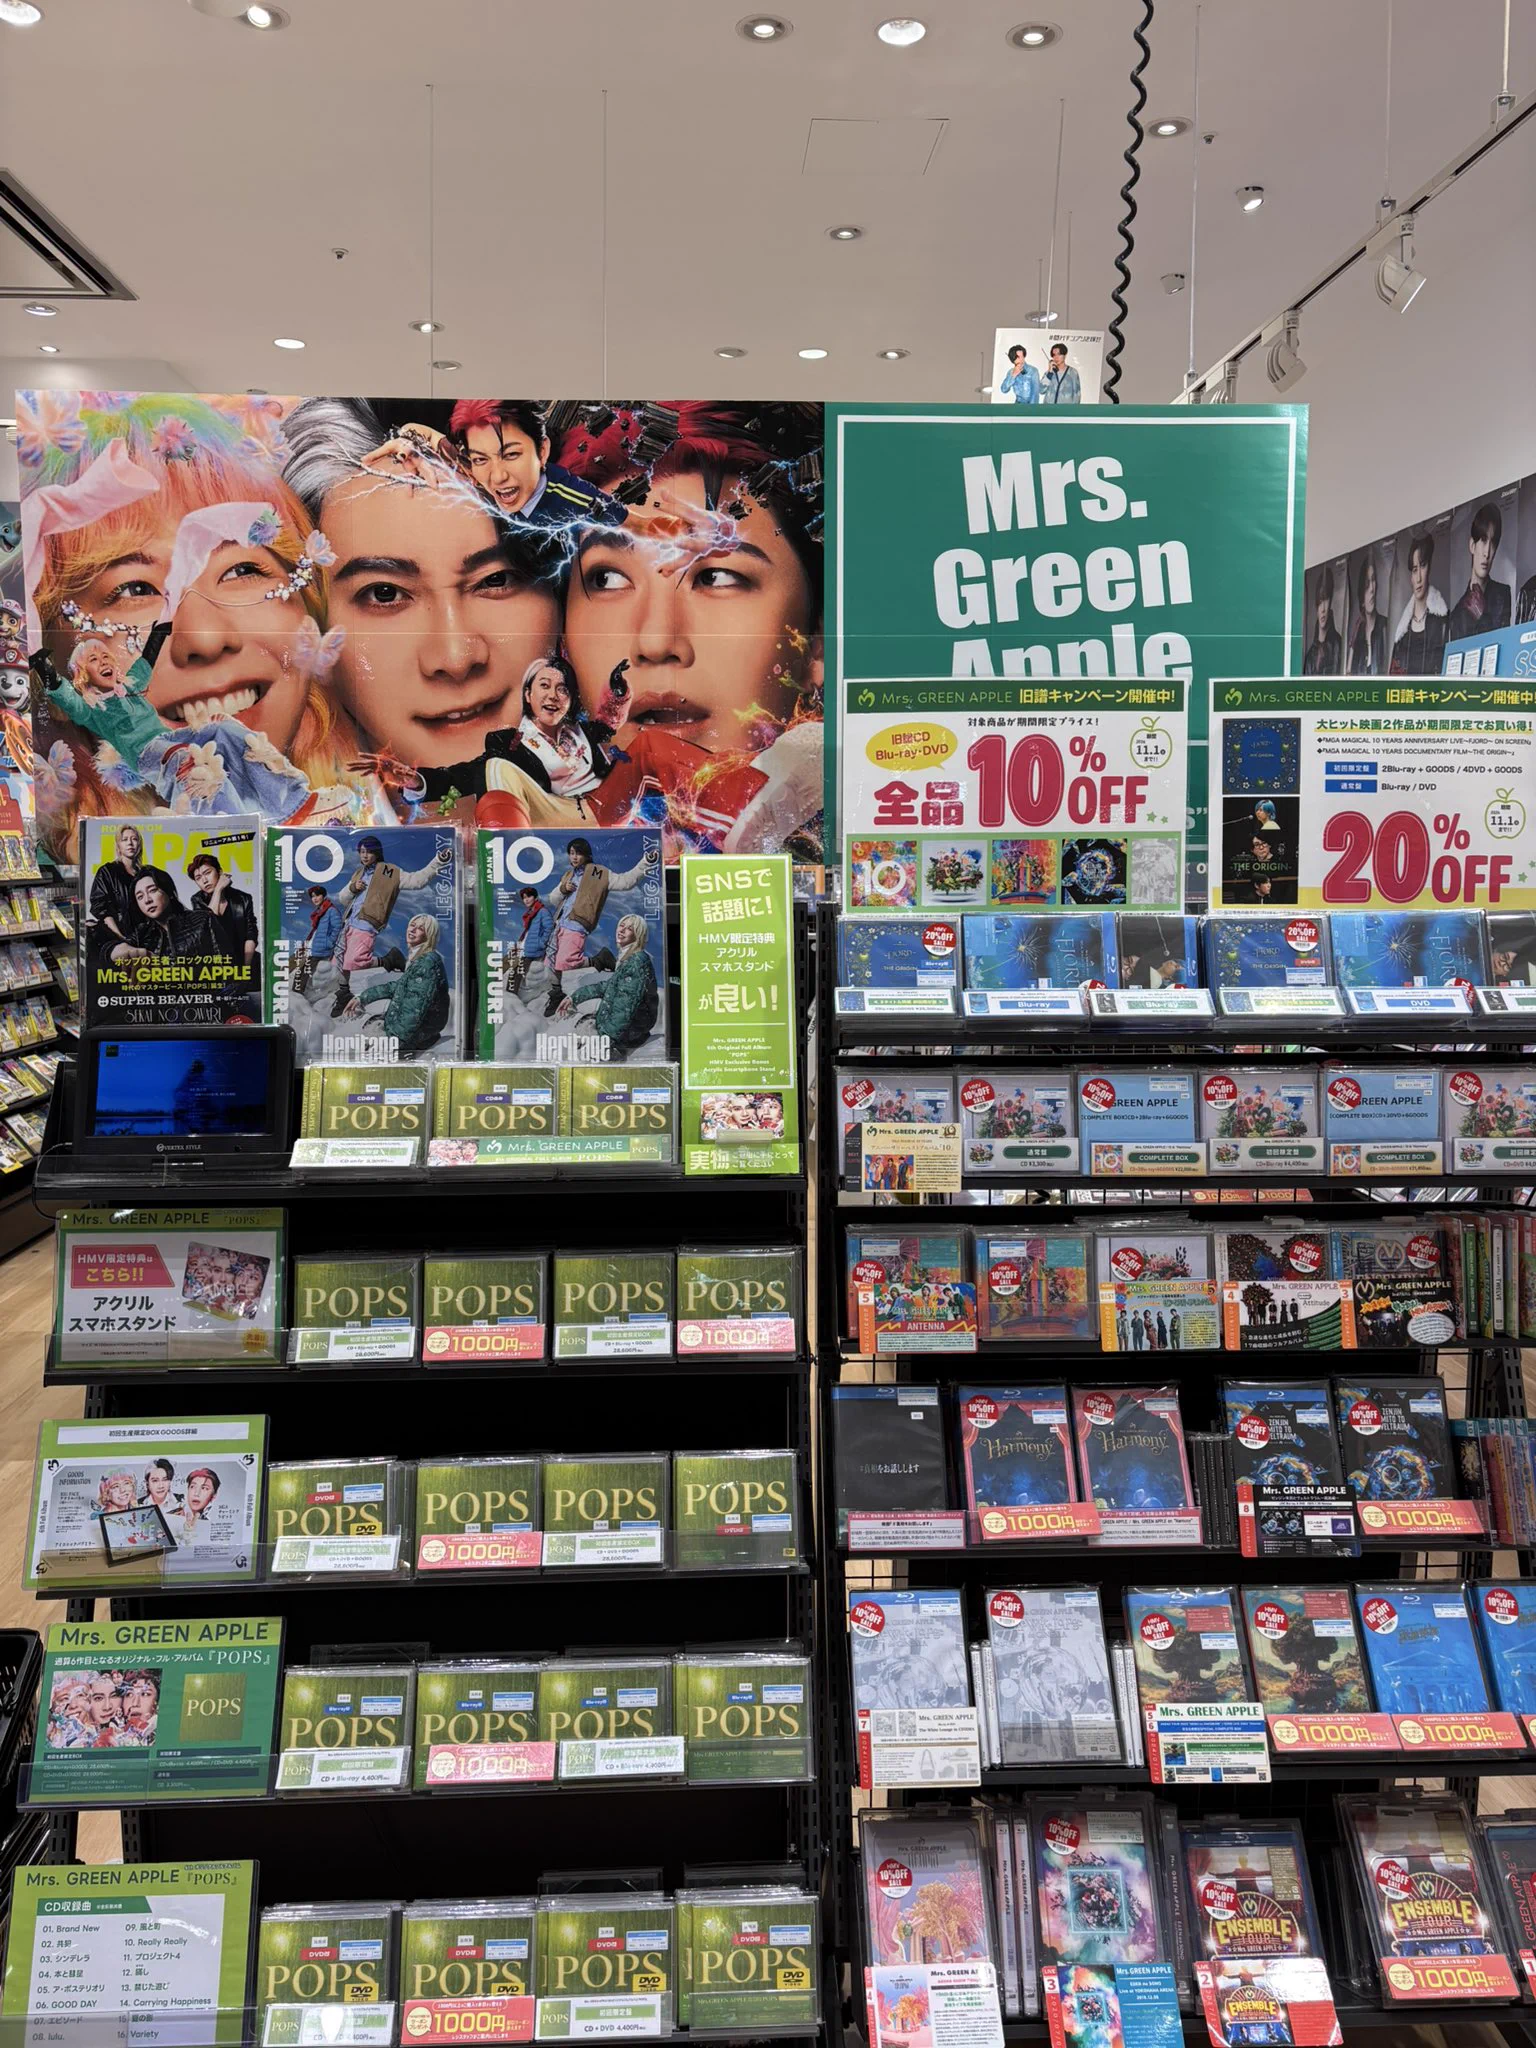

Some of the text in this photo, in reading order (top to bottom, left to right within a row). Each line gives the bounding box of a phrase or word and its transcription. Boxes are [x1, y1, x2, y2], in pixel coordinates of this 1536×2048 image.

[962, 451, 1147, 535] Mrs.
[933, 540, 1192, 629] Green
[881, 692, 913, 705] Mrs.
[917, 691, 966, 704] GREEN
[969, 691, 1012, 704] APPLE
[1249, 691, 1280, 704] Mrs.
[1285, 691, 1333, 703] GREEN
[1336, 691, 1379, 703] APPLE
[1425, 765, 1455, 774] GOODS
[1462, 765, 1485, 774] 4DVD
[1494, 765, 1523, 774] GOODS
[1381, 783, 1411, 792] Blu-ray
[1418, 783, 1437, 791] DVD
[873, 781, 964, 826] 全品
[1067, 775, 1149, 824] OFF
[274, 834, 345, 883] 10
[486, 836, 554, 885] 10
[435, 834, 453, 921] LEGACY
[643, 835, 660, 921] LEGACY
[695, 868, 773, 895] SNSで
[1431, 855, 1513, 903] OFF
[701, 895, 773, 924] 話題に!
[698, 932, 776, 944] HMV限定特典
[925, 931, 954, 943] 20%OFF
[1288, 926, 1317, 938] 20%OFF
[716, 947, 758, 958] アクリル
[97, 965, 251, 984] Mrs. GREEN APPLE
[700, 960, 774, 973] スマホスタンド
[273, 940, 290, 1025] FUTURE
[487, 940, 503, 1025] FUTURE
[110, 995, 213, 1007] SUPER BEAVER
[698, 983, 778, 1014] が良い!
[1017, 1000, 1050, 1009] Blu-ray
[1411, 999, 1430, 1008] DVD
[125, 1008, 222, 1024] SEKAI NO OWARI
[322, 1033, 399, 1063] Heritage
[536, 1033, 611, 1063] Heritage
[963, 1086, 991, 1101] 10%OFF
[1087, 1083, 1114, 1101] 10%OFF
[1207, 1085, 1234, 1094] 10%OFF
[328, 1105, 419, 1131] POPS
[457, 1105, 547, 1130] POPS
[579, 1104, 667, 1129] POPS
[539, 1141, 583, 1152] GREEN
[585, 1140, 623, 1151] APPLE
[72, 1213, 103, 1226] Mrs.
[109, 1213, 158, 1225] GREEN
[163, 1212, 210, 1224] APPLE
[1293, 1245, 1320, 1261] 10%OFF
[1411, 1243, 1438, 1256] 10%OFF
[86, 1267, 144, 1282] こちら!!
[991, 1269, 1018, 1280] 10%OFF
[1395, 1282, 1423, 1290] GREEN
[1424, 1280, 1452, 1289] APPLE
[93, 1296, 154, 1312] アクリル
[303, 1286, 408, 1318] POPS
[430, 1284, 534, 1317] POPS
[562, 1281, 664, 1313] POPS
[684, 1280, 786, 1312] POPS
[69, 1316, 176, 1332] スマホスタンド
[907, 1322, 945, 1331] ANTENNA
[452, 1336, 518, 1352] 1000円
[968, 1403, 995, 1414] 10%OFF
[1351, 1411, 1378, 1420] 10%OFF
[980, 1437, 1056, 1462] Harmony
[1096, 1431, 1170, 1456] Harmony
[684, 1481, 787, 1516] POPS
[1263, 1486, 1347, 1495] Mrs. GREEN APPLE
[424, 1490, 528, 1525] POPS
[552, 1488, 656, 1521] POPS
[1007, 1513, 1076, 1531] 1000円
[1387, 1509, 1455, 1526] 1000円
[449, 1544, 515, 1560] 1000円
[992, 1600, 1021, 1613] 10%OFF
[1256, 1610, 1286, 1624] 10%OFF
[60, 1622, 269, 1646] Mrs. GREEN APPLE
[186, 1698, 241, 1717] POPS
[1160, 1706, 1260, 1717] Mrs. GREEN APPLE
[421, 1712, 528, 1746] POPS
[549, 1708, 654, 1741] POPS
[694, 1705, 799, 1738] POPS
[289, 1716, 397, 1749] POPS
[1299, 1723, 1371, 1743] 1000円
[1424, 1723, 1496, 1743] 1000円
[26, 1872, 60, 1886] Mrs.
[66, 1871, 121, 1886] GREEN
[128, 1869, 180, 1883] APPLE
[879, 1867, 908, 1881] 10%OFF
[1379, 1868, 1410, 1885] 10%OFF
[1205, 1888, 1235, 1904] 10%OFF
[44, 1901, 91, 1912] CD収録曲
[1391, 1899, 1473, 1928] ENSEMBLE
[56, 1925, 80, 1933] Brand
[1215, 1917, 1292, 1945] ENSEMBLE
[137, 1937, 188, 1947] Really Really
[56, 1955, 90, 1963] シンデレラ
[135, 1952, 181, 1961] プロジェクト4
[555, 1952, 664, 1990] POPS
[697, 1947, 808, 1985] POPS
[264, 1961, 377, 1999] POPS
[411, 1961, 523, 1998] POPS
[783, 1971, 804, 1979] DVD
[1416, 1968, 1488, 1988] 1000円
[51, 2000, 97, 2009] GOOD DAY
[133, 1996, 211, 2008] Carrying Happiness
[434, 2012, 506, 2033] 1000円
[130, 2030, 159, 2040] Variety
